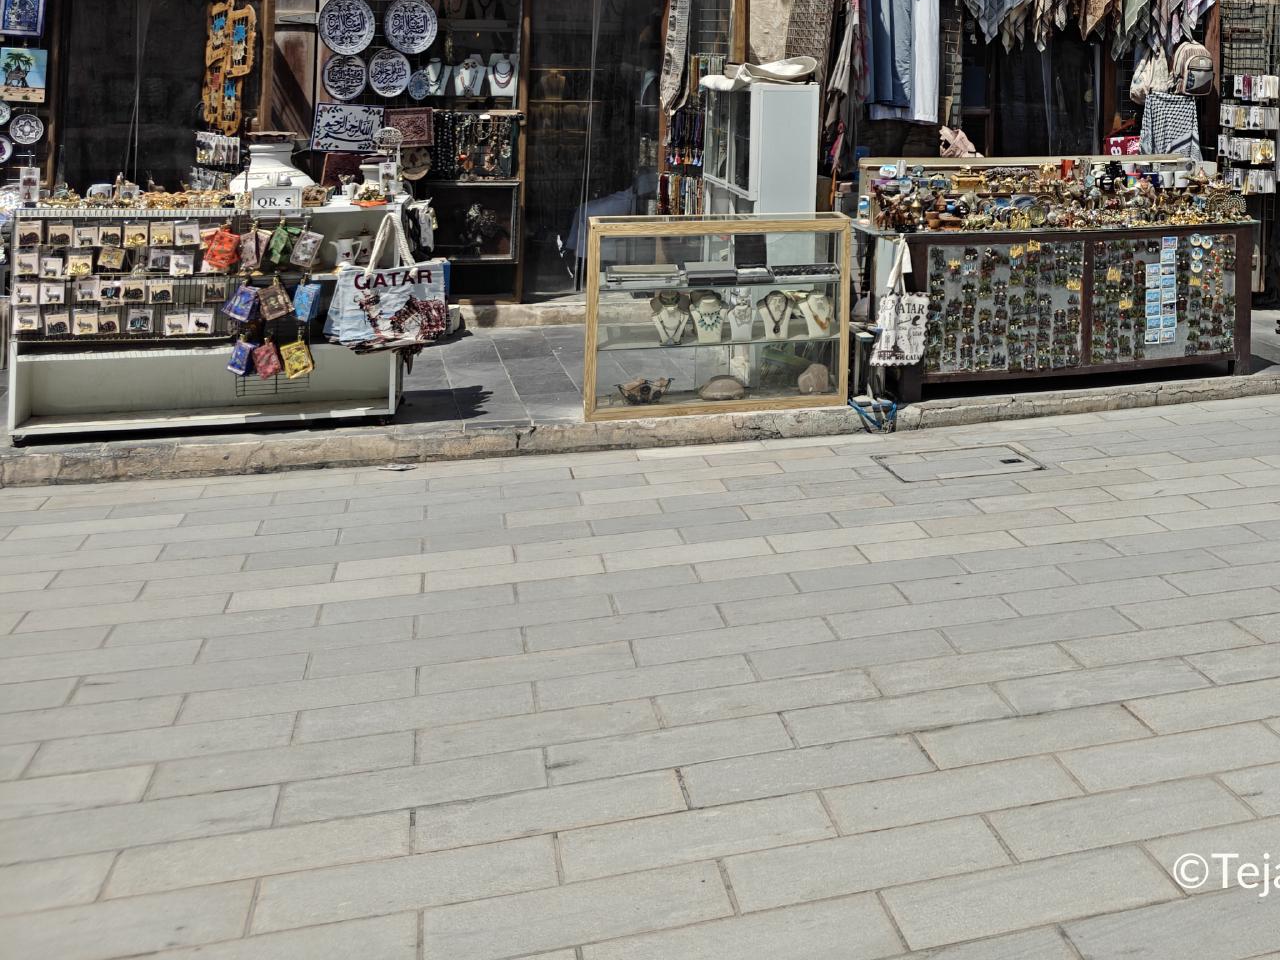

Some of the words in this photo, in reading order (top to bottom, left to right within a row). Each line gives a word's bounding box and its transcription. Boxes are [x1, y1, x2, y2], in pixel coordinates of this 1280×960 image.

[257, 197, 281, 209] QR.
[284, 197, 292, 207] 5
[354, 269, 433, 291] QATAR
